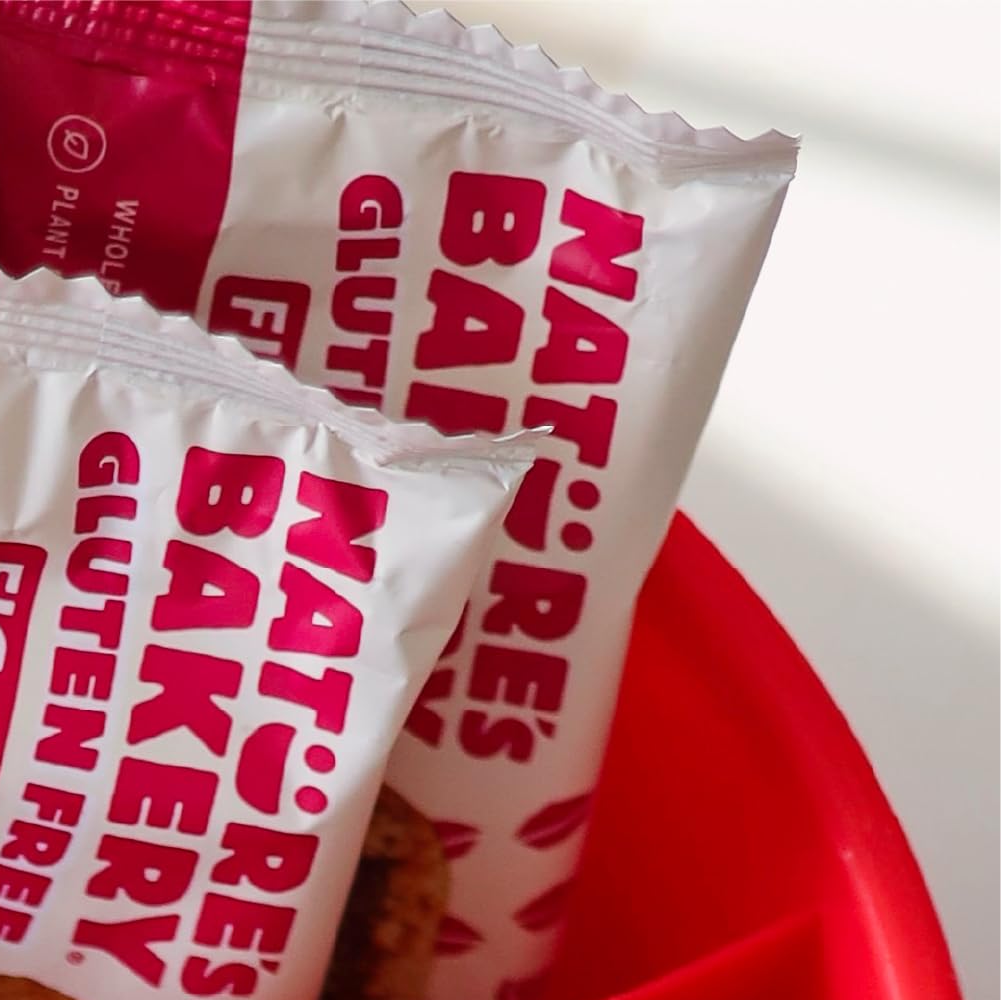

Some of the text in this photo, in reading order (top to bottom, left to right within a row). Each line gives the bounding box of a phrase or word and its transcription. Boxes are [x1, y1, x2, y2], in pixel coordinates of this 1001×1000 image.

[42, 184, 80, 260] PLANT
[326, 174, 403, 408] GLUT
[34, 431, 140, 771] GLUTEN
